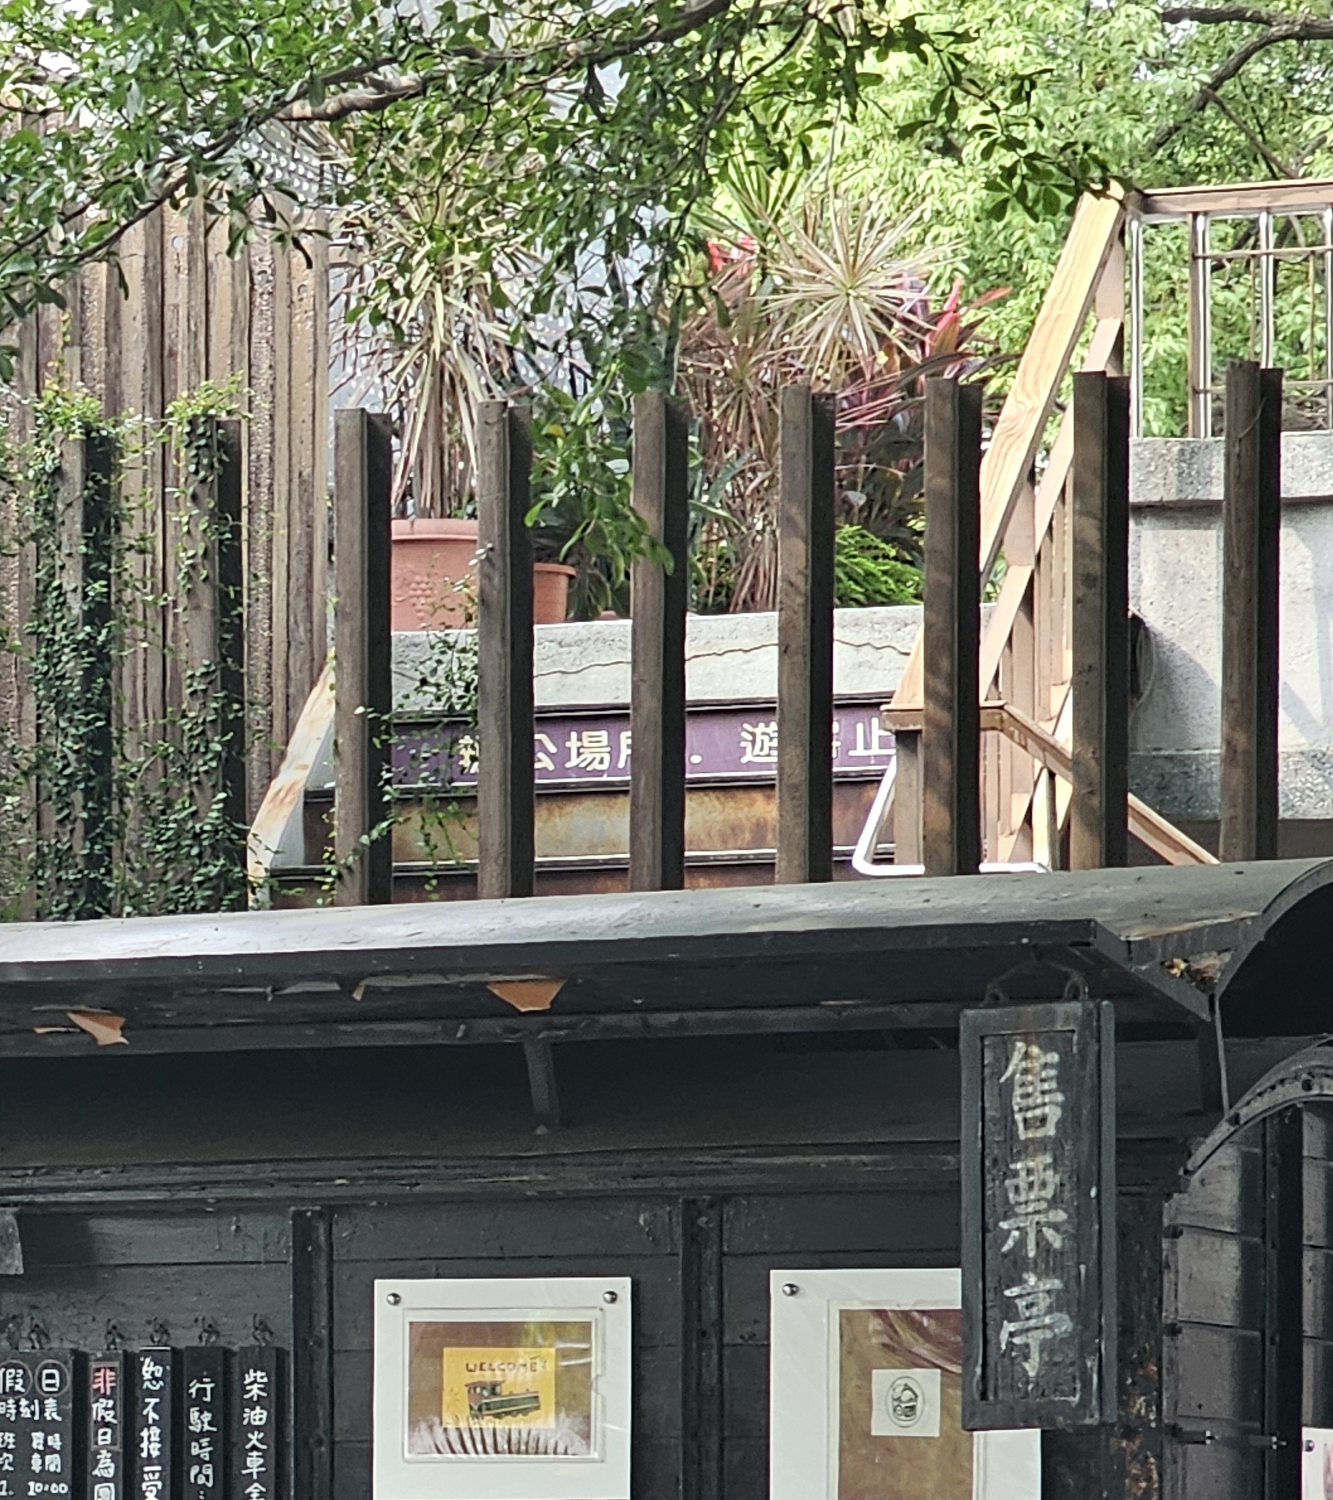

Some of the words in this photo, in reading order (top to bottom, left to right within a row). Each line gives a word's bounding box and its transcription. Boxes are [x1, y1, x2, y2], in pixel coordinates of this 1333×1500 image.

[999, 1041, 1073, 1377] 售票亭
[27, 1481, 68, 1497] 10:00
